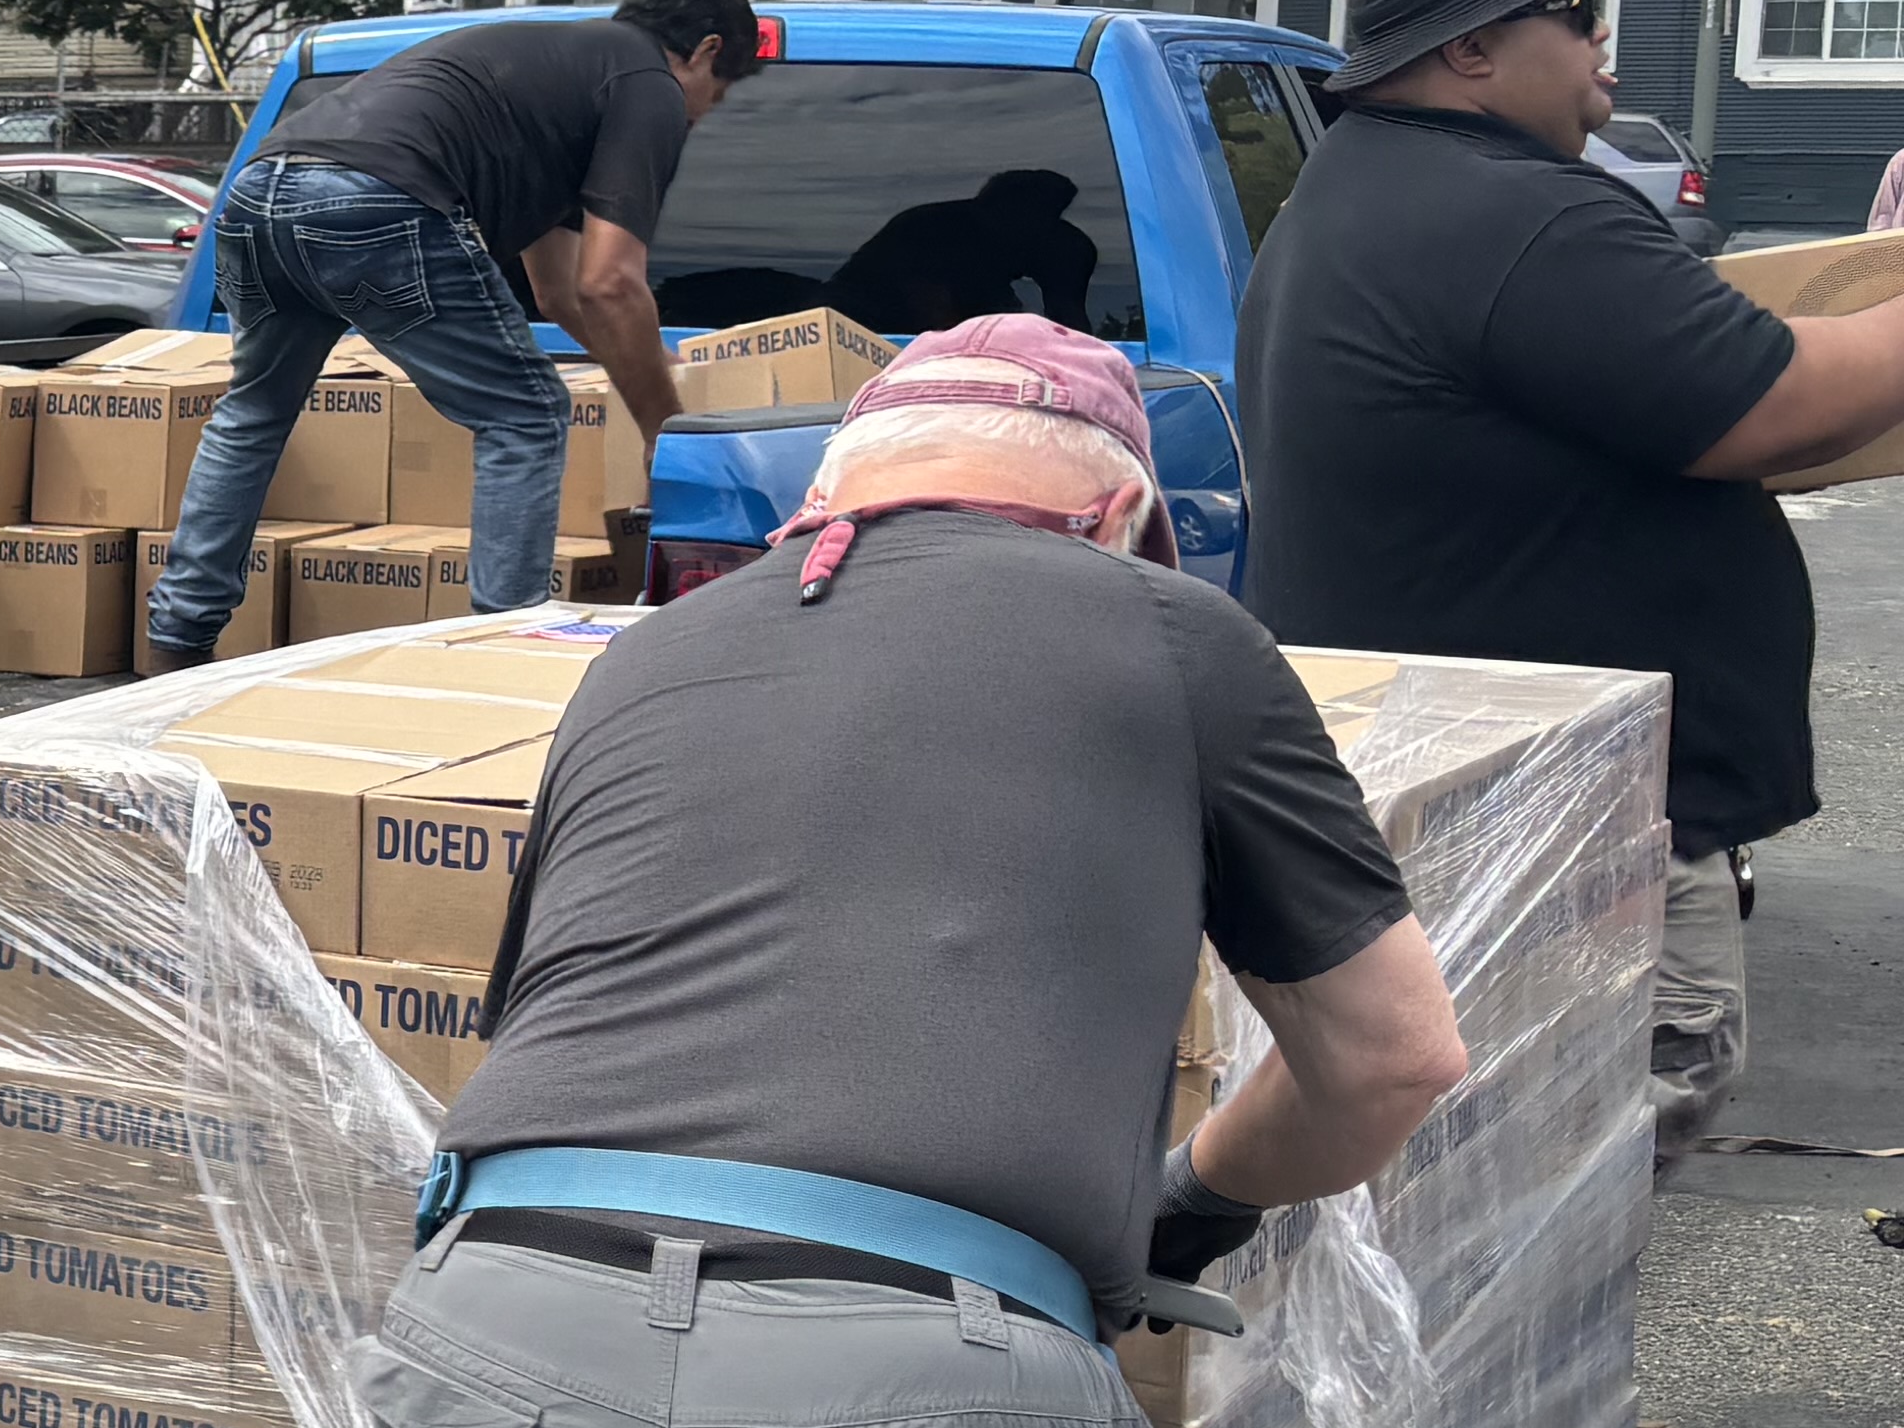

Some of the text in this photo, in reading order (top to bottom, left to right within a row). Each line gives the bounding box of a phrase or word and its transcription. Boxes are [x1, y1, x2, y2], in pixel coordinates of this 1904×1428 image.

[758, 322, 820, 355] BEANS
[835, 322, 868, 358] BLACK
[9, 396, 36, 419] BLA
[46, 393, 162, 420] BLACK BEANS
[325, 390, 382, 413] BEANS
[570, 403, 606, 427] ACK
[24, 540, 78, 565] BEANS
[301, 557, 421, 588] BLACK BEANS
[440, 561, 468, 584] BLA
[376, 815, 490, 871] DICED
[74, 1095, 267, 1166] TOMATOES
[23, 1237, 210, 1313] TOMATOES
